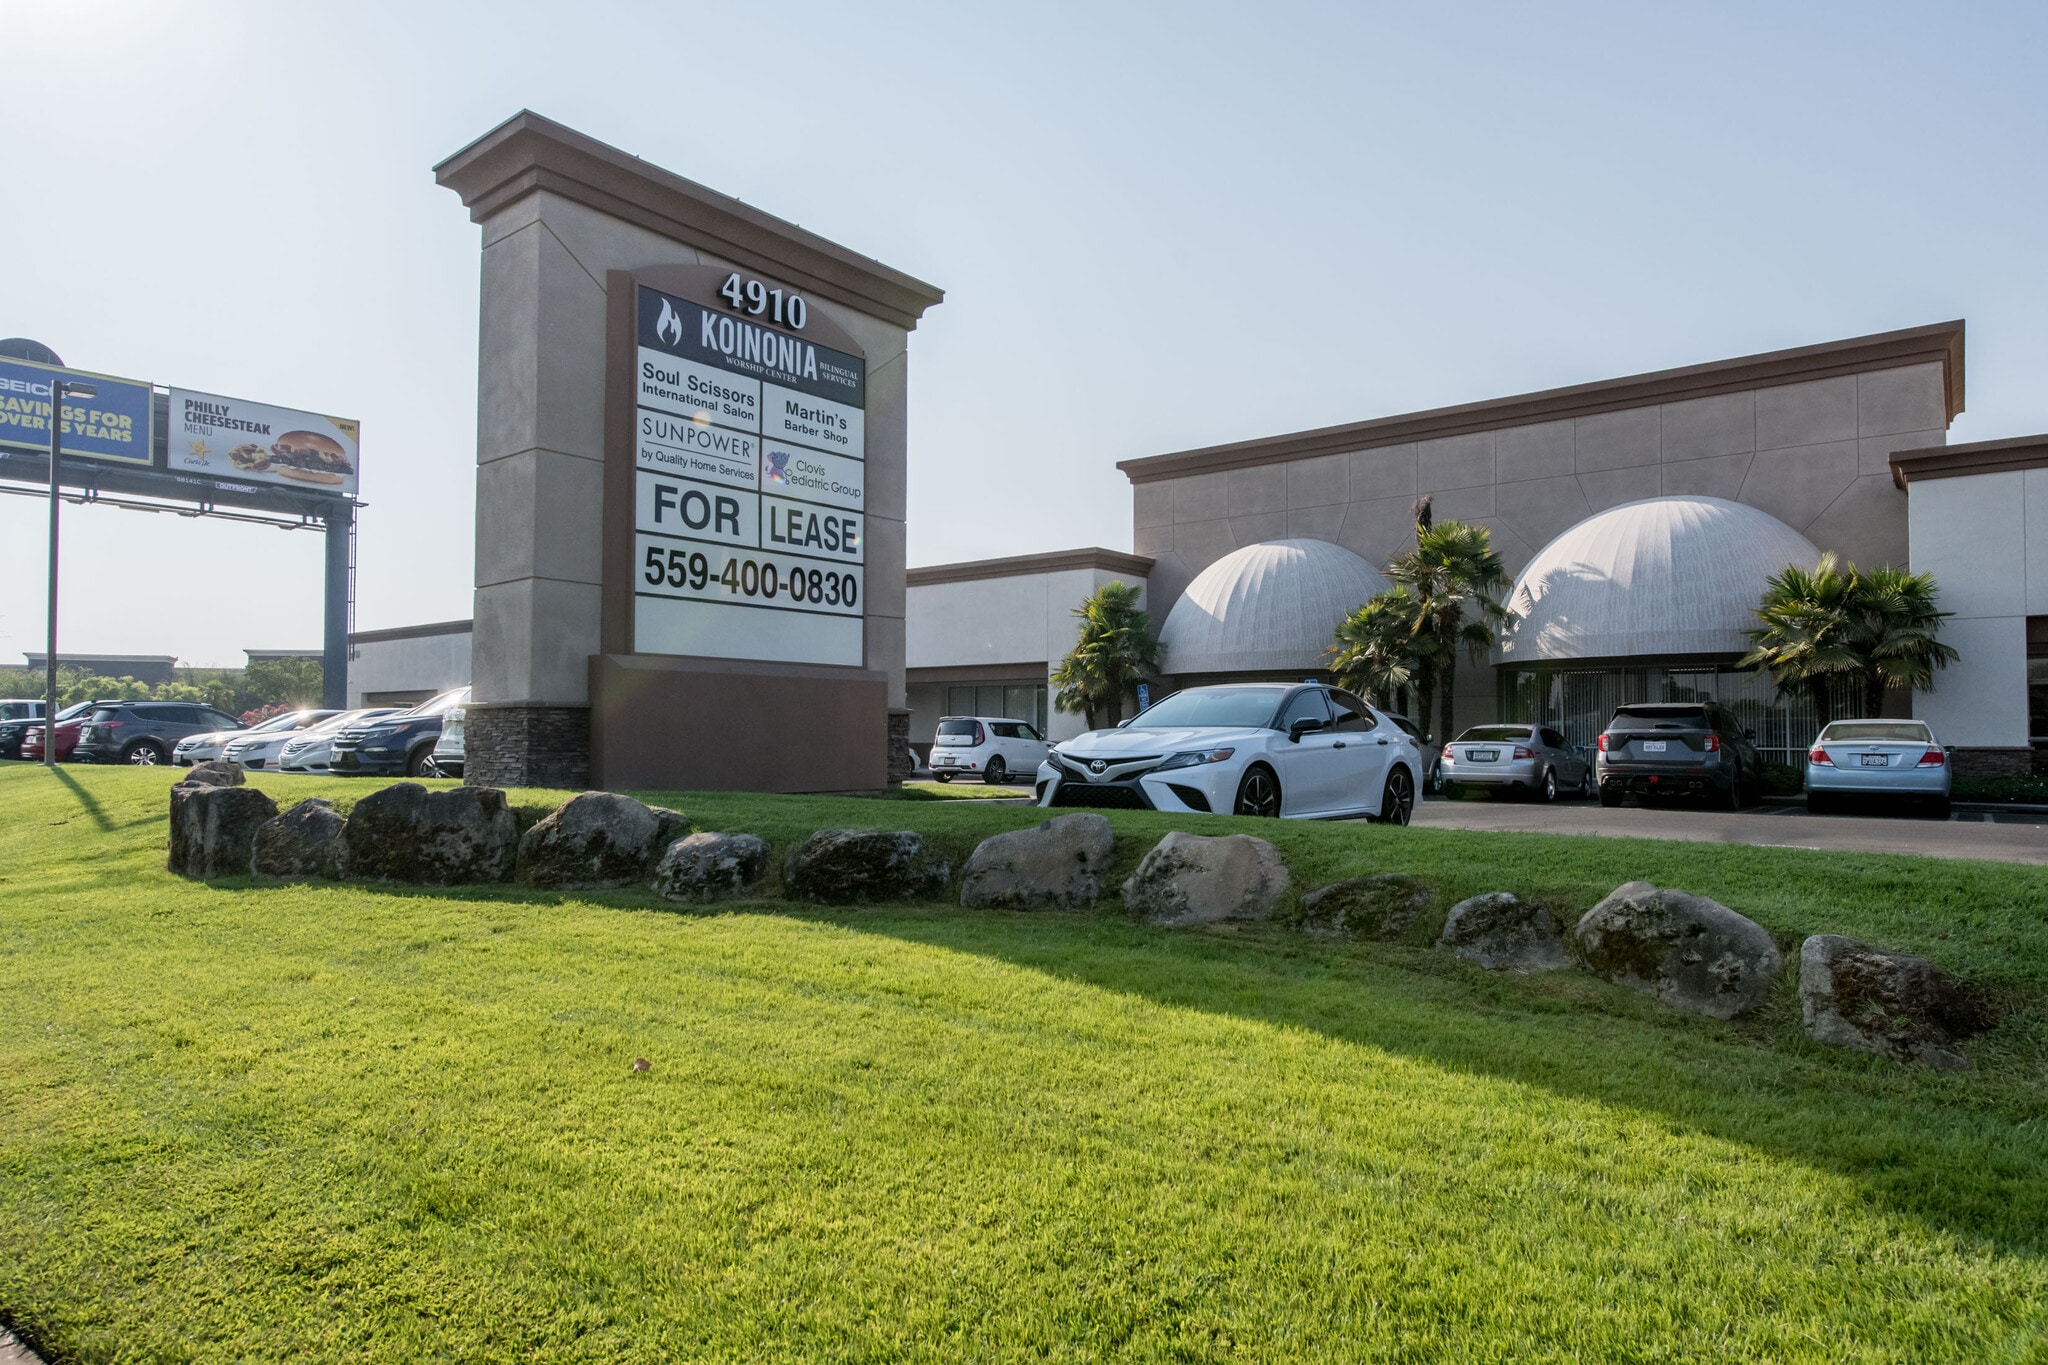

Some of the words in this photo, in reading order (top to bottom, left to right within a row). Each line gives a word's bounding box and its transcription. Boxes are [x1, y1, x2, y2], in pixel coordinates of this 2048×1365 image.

[720, 272, 807, 330] 4910
[701, 310, 818, 381] KOINONIA
[725, 355, 765, 374] WORSHIP
[765, 368, 798, 384] CENTER
[820, 361, 858, 380] BILINGUAL
[822, 372, 856, 388] SERVICES
[642, 362, 680, 387] Soul
[687, 374, 755, 407] Scissors
[184, 398, 230, 417] PHILLY
[642, 382, 718, 411] International
[723, 404, 754, 421] Salon
[785, 400, 847, 430] Martin's
[73, 422, 132, 443] YEARS
[89, 410, 132, 430] FOR
[184, 411, 271, 436] CHEESESTEAK
[184, 422, 213, 437] MENU
[784, 419, 819, 437] Barber
[823, 429, 848, 445] Shop
[642, 417, 750, 458] SUNPOWER
[641, 448, 653, 461] by
[655, 450, 688, 469] Quality
[690, 459, 717, 474] Home
[719, 463, 755, 481] Services
[796, 459, 826, 476] Clovis
[831, 481, 861, 499] Group
[654, 483, 740, 536] FOR
[770, 505, 857, 554] LEASE
[644, 546, 857, 608] 559-400-0830
